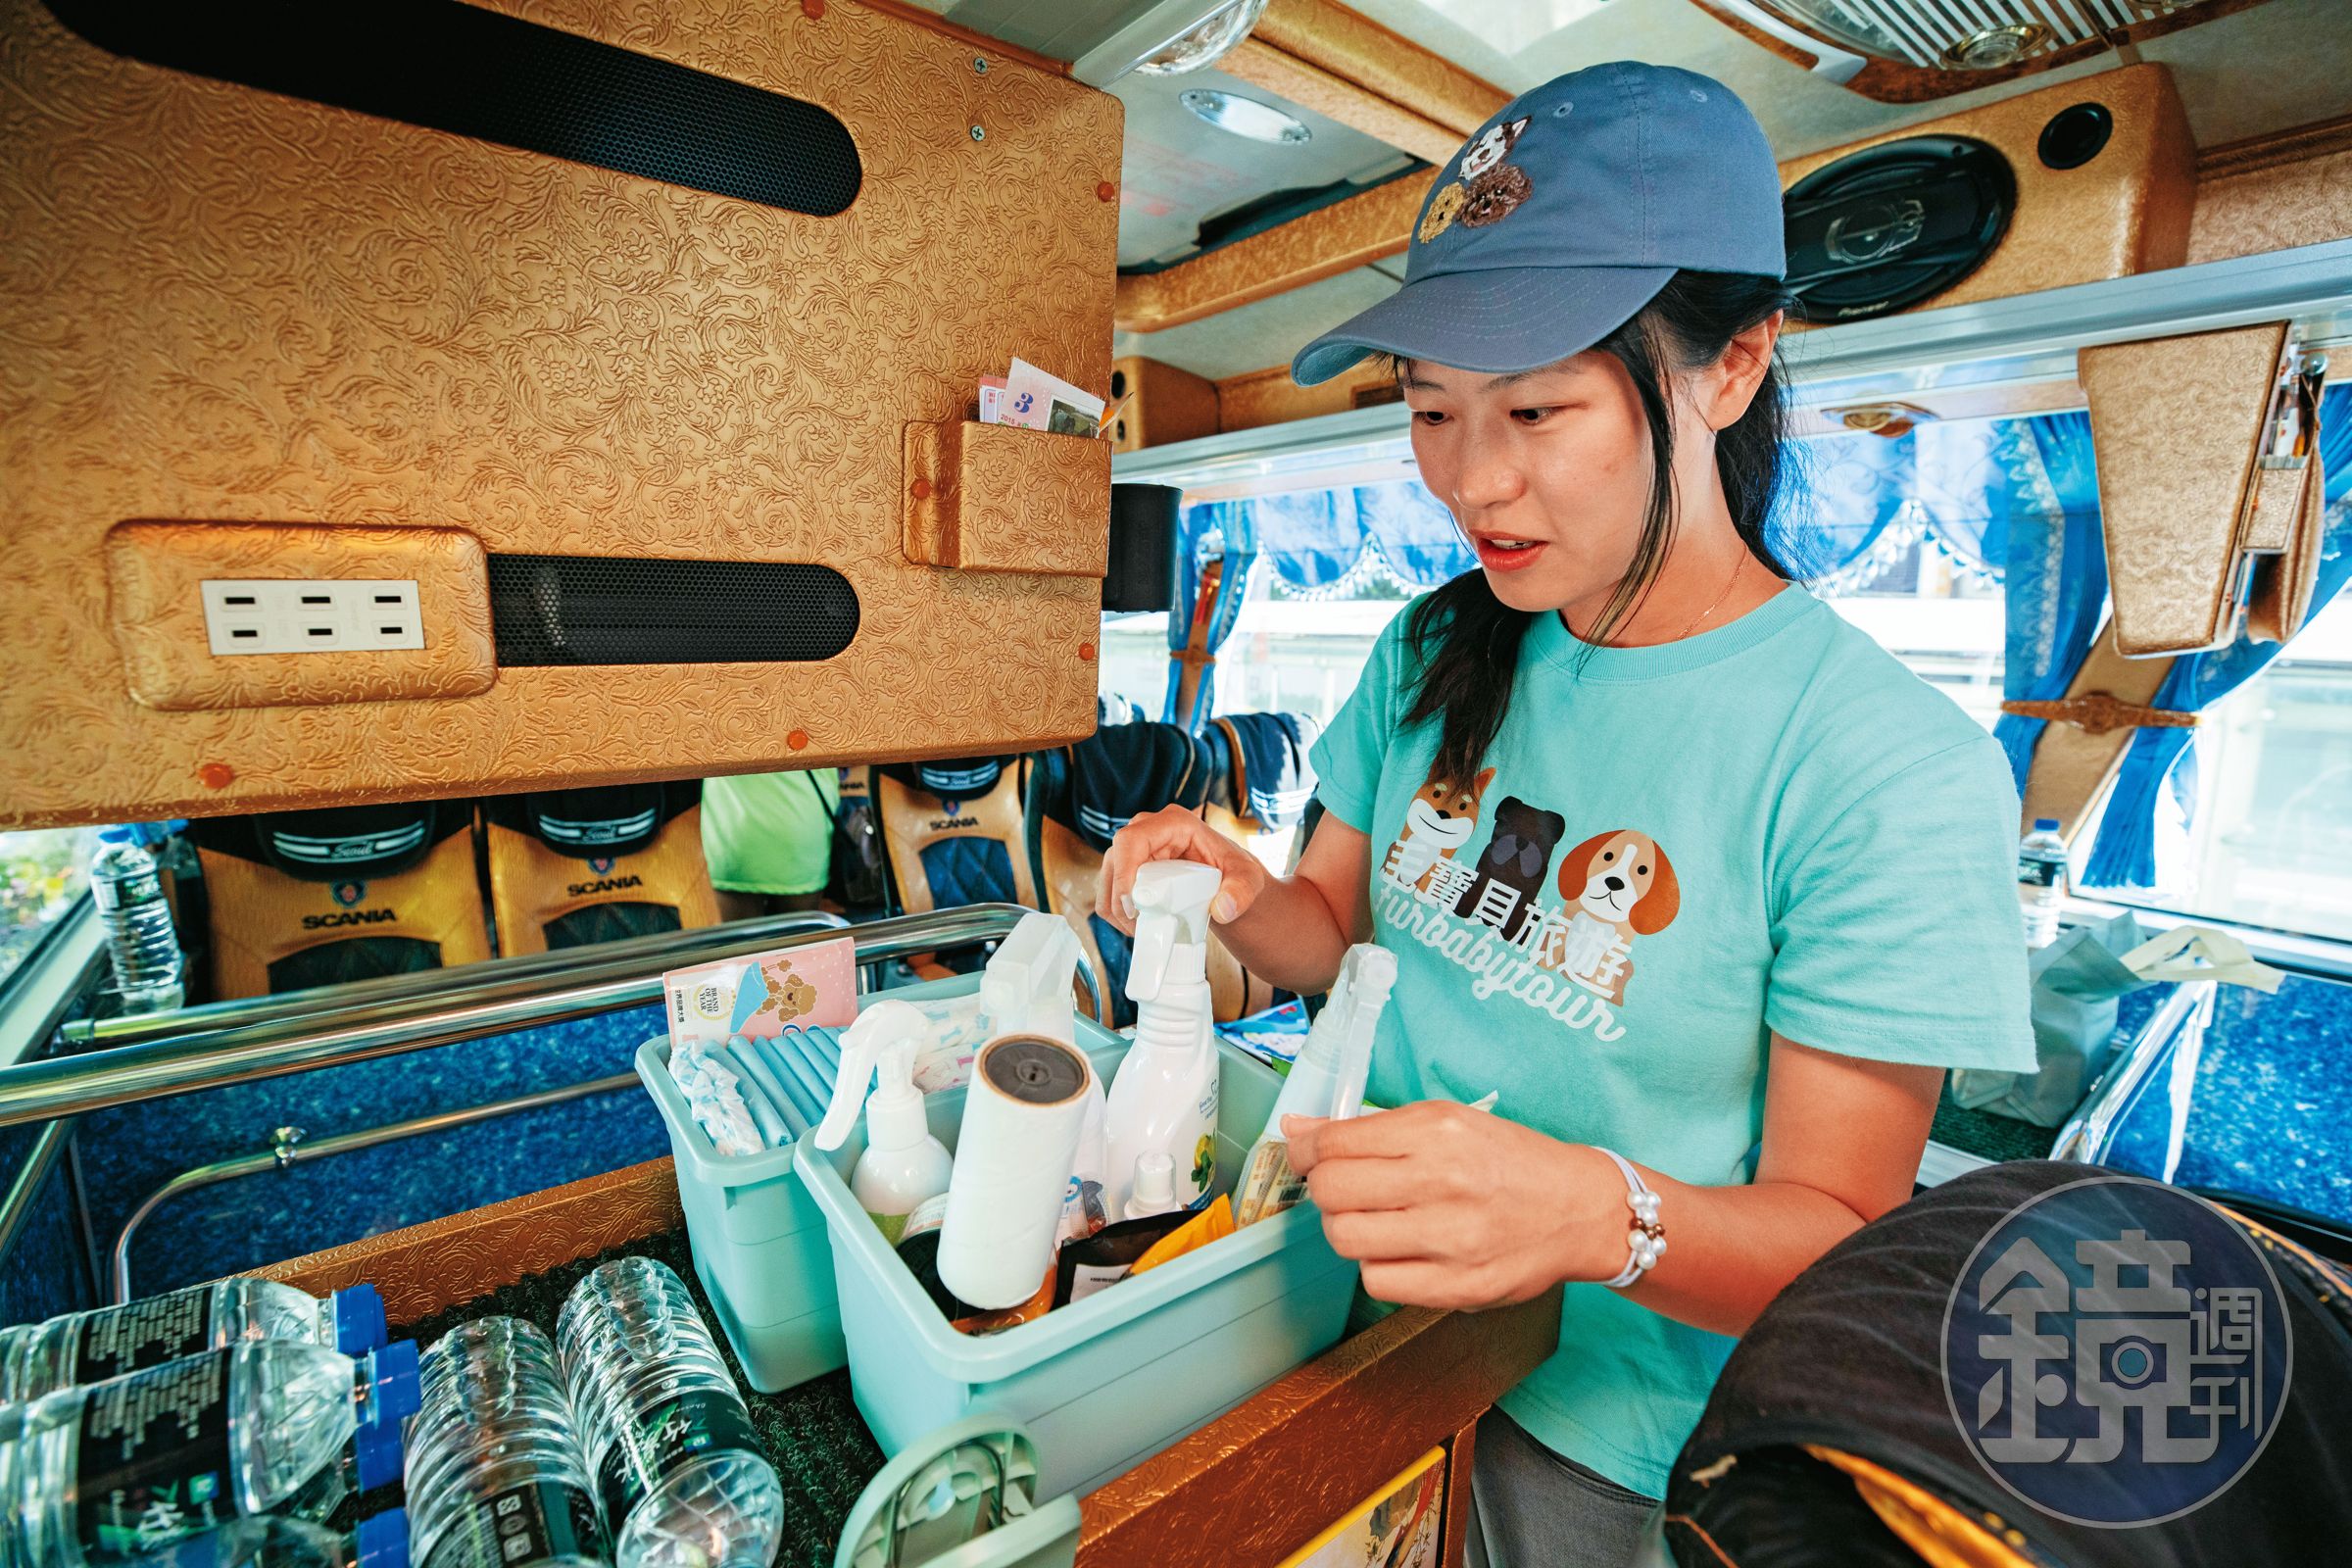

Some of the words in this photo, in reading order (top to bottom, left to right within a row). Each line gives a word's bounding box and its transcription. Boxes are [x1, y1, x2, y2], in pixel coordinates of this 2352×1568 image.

[1014, 392, 1034, 413] 3
[1000, 414, 1015, 425] 2015
[566, 874, 643, 897] SCANIA
[301, 908, 396, 929] SCANIA
[1379, 840, 1633, 999] 毛寶貝旅遊
